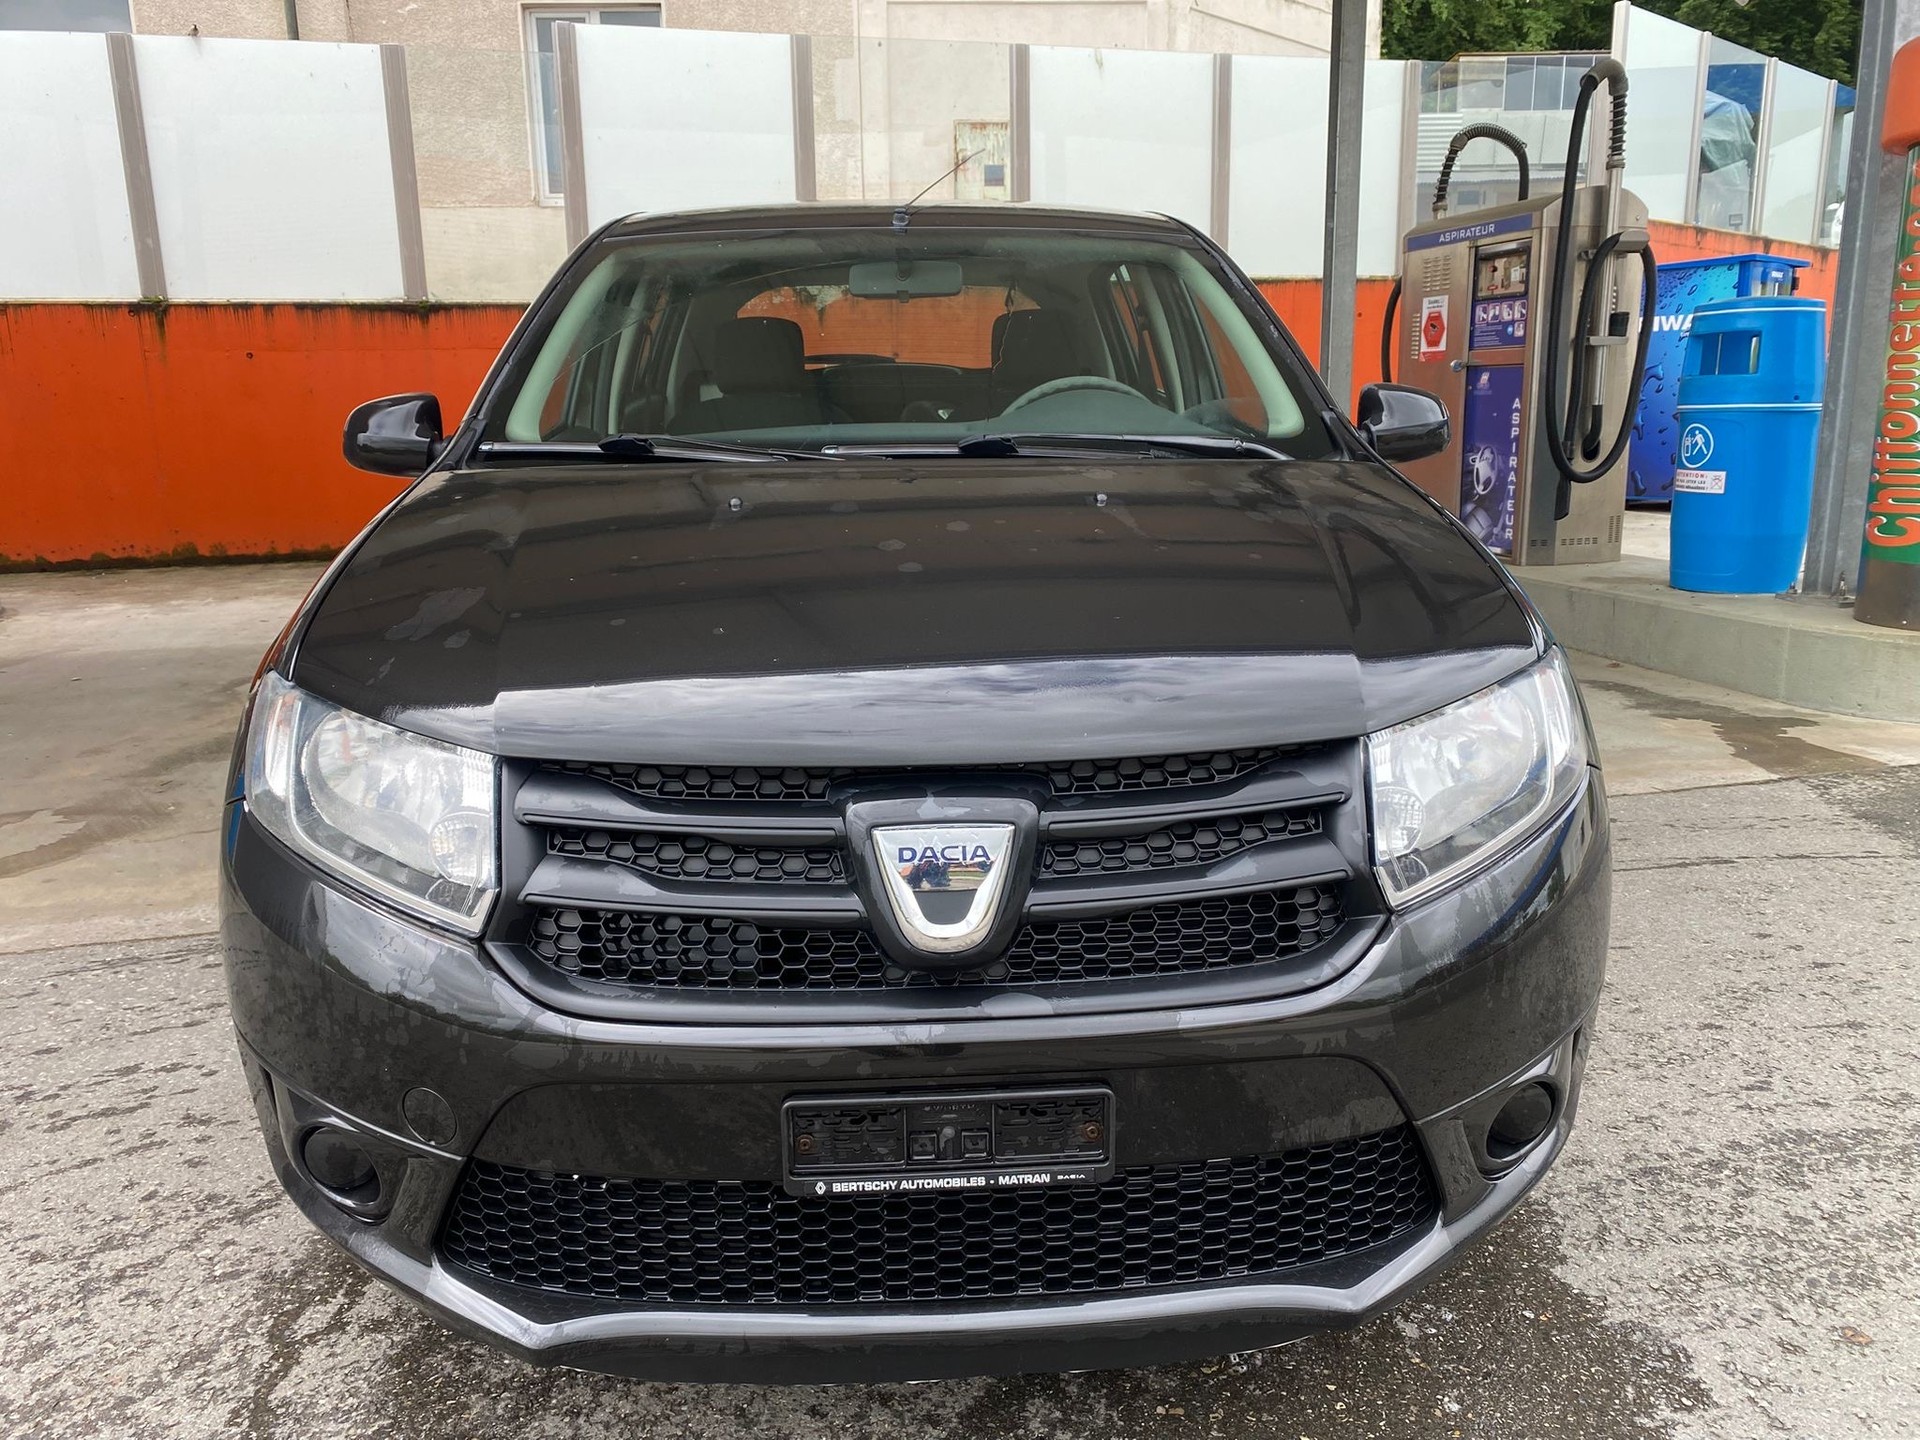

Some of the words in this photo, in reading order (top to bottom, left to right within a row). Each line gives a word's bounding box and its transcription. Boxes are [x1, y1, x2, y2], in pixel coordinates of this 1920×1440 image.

[1438, 223, 1496, 243] ASPIRATEUR
[1504, 397, 1521, 540] ASPIRATEUR
[898, 845, 991, 864] DACIA
[832, 1179, 898, 1193] BERTSCHY
[899, 1176, 986, 1191] AUTOMOBILES
[998, 1173, 1050, 1186] MATRAN
